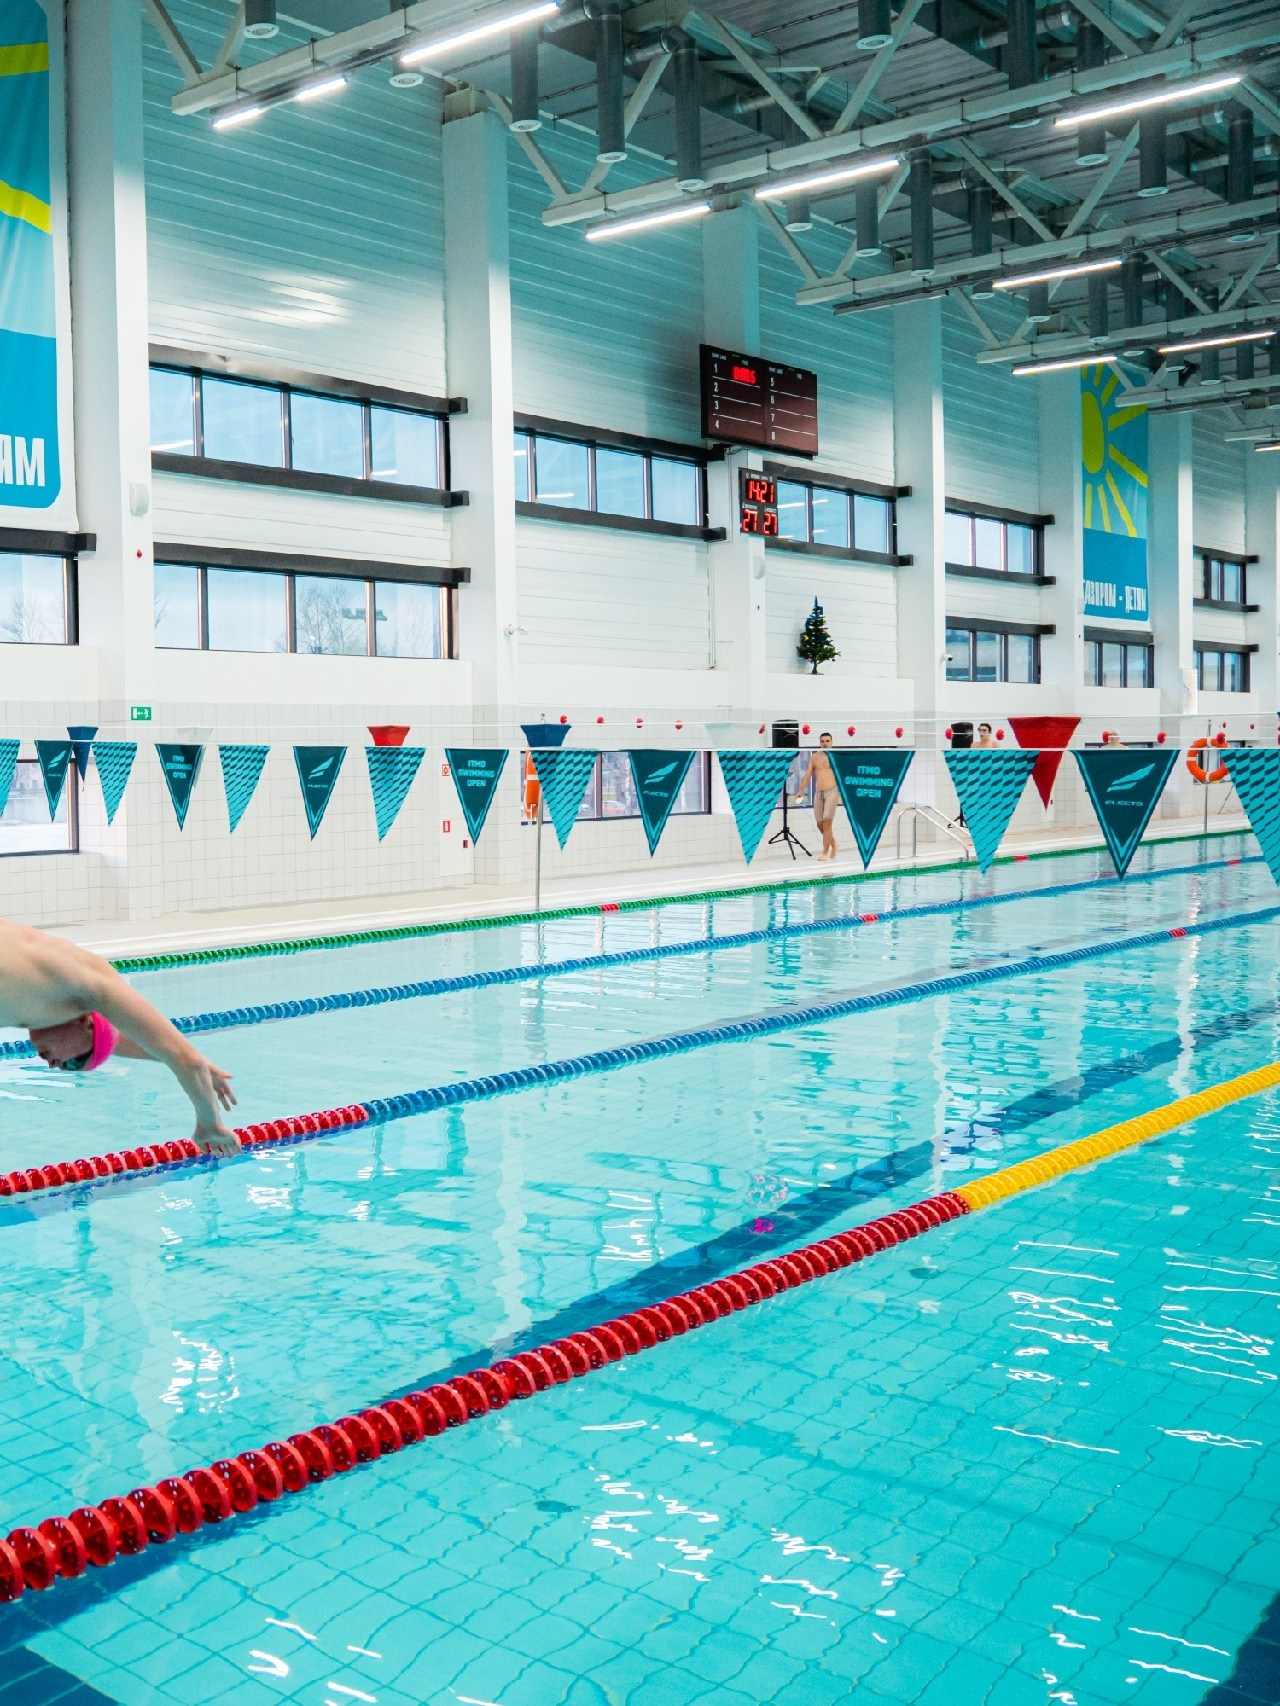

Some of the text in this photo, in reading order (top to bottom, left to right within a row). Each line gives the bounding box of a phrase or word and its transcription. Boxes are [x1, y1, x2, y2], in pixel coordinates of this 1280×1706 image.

[857, 765, 881, 775] ITMO
[844, 776, 894, 787] SWIMMING
[856, 788, 882, 798] OPEN
